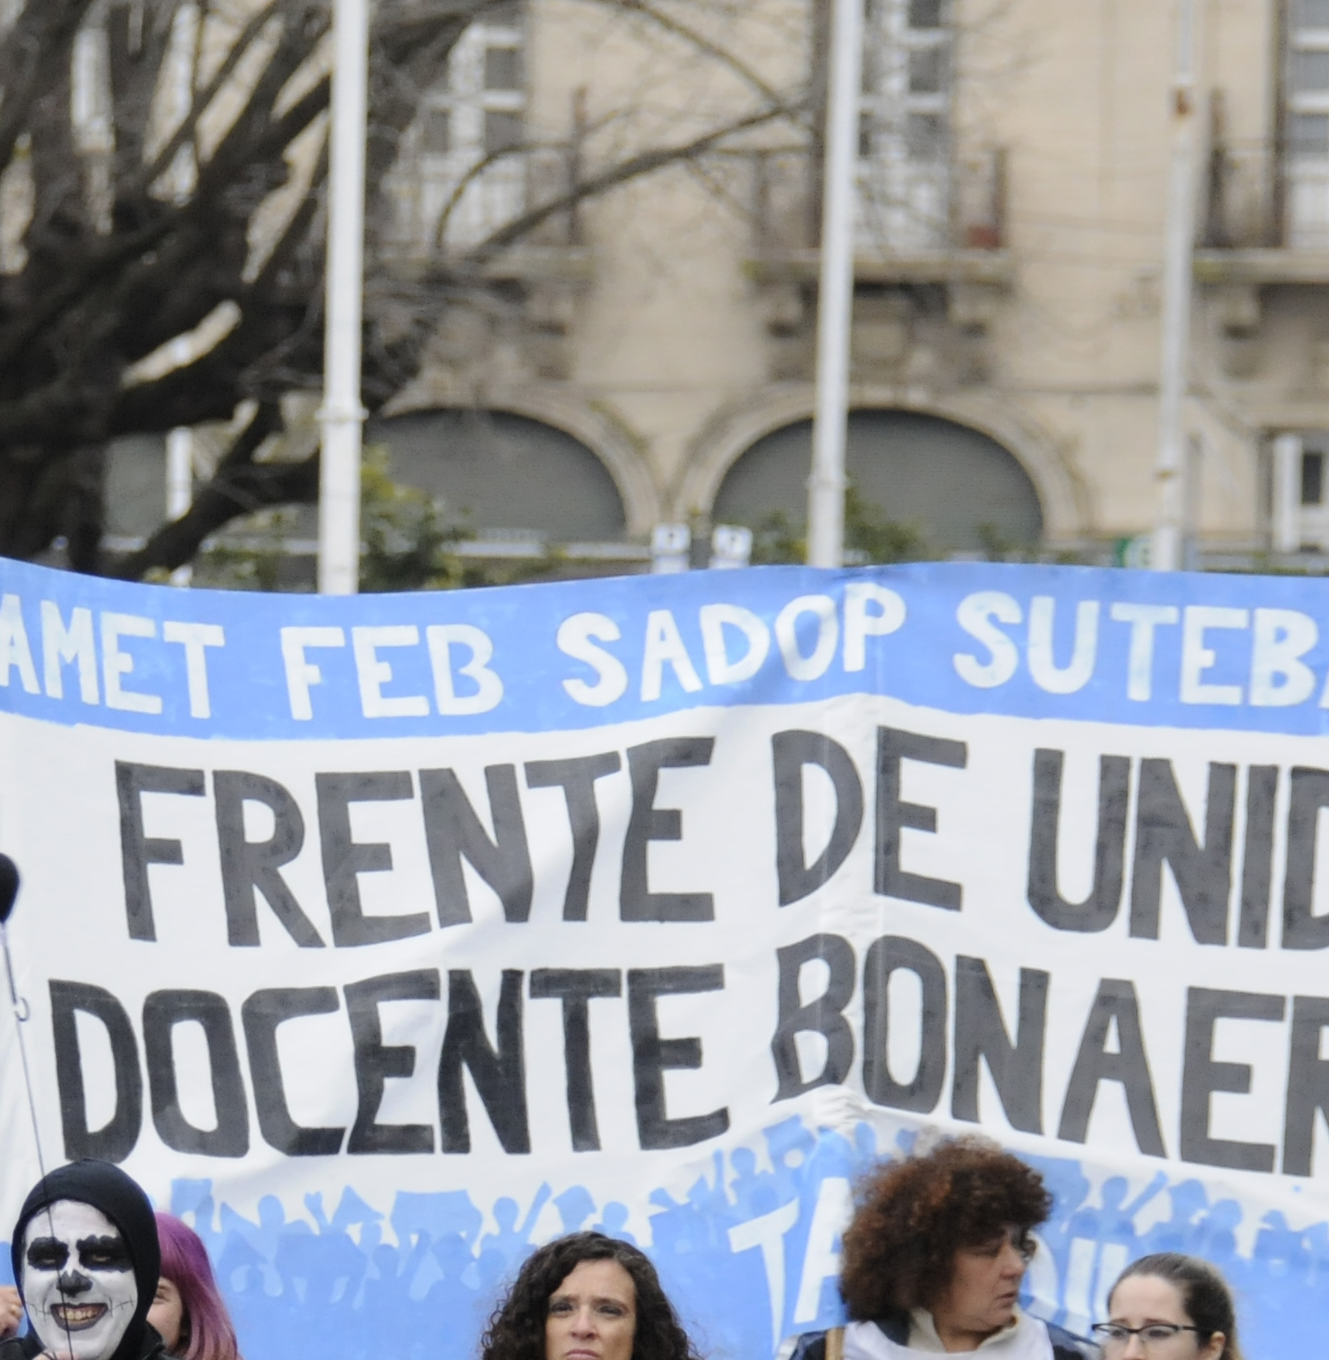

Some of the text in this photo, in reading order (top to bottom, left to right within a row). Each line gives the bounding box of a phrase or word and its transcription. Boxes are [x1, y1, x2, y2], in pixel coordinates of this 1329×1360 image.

[279, 622, 505, 721] FEB
[555, 581, 908, 708] SADOP
[114, 735, 716, 950] FRENTE
[771, 726, 968, 912] DE
[47, 962, 732, 1166] DOCENTE
